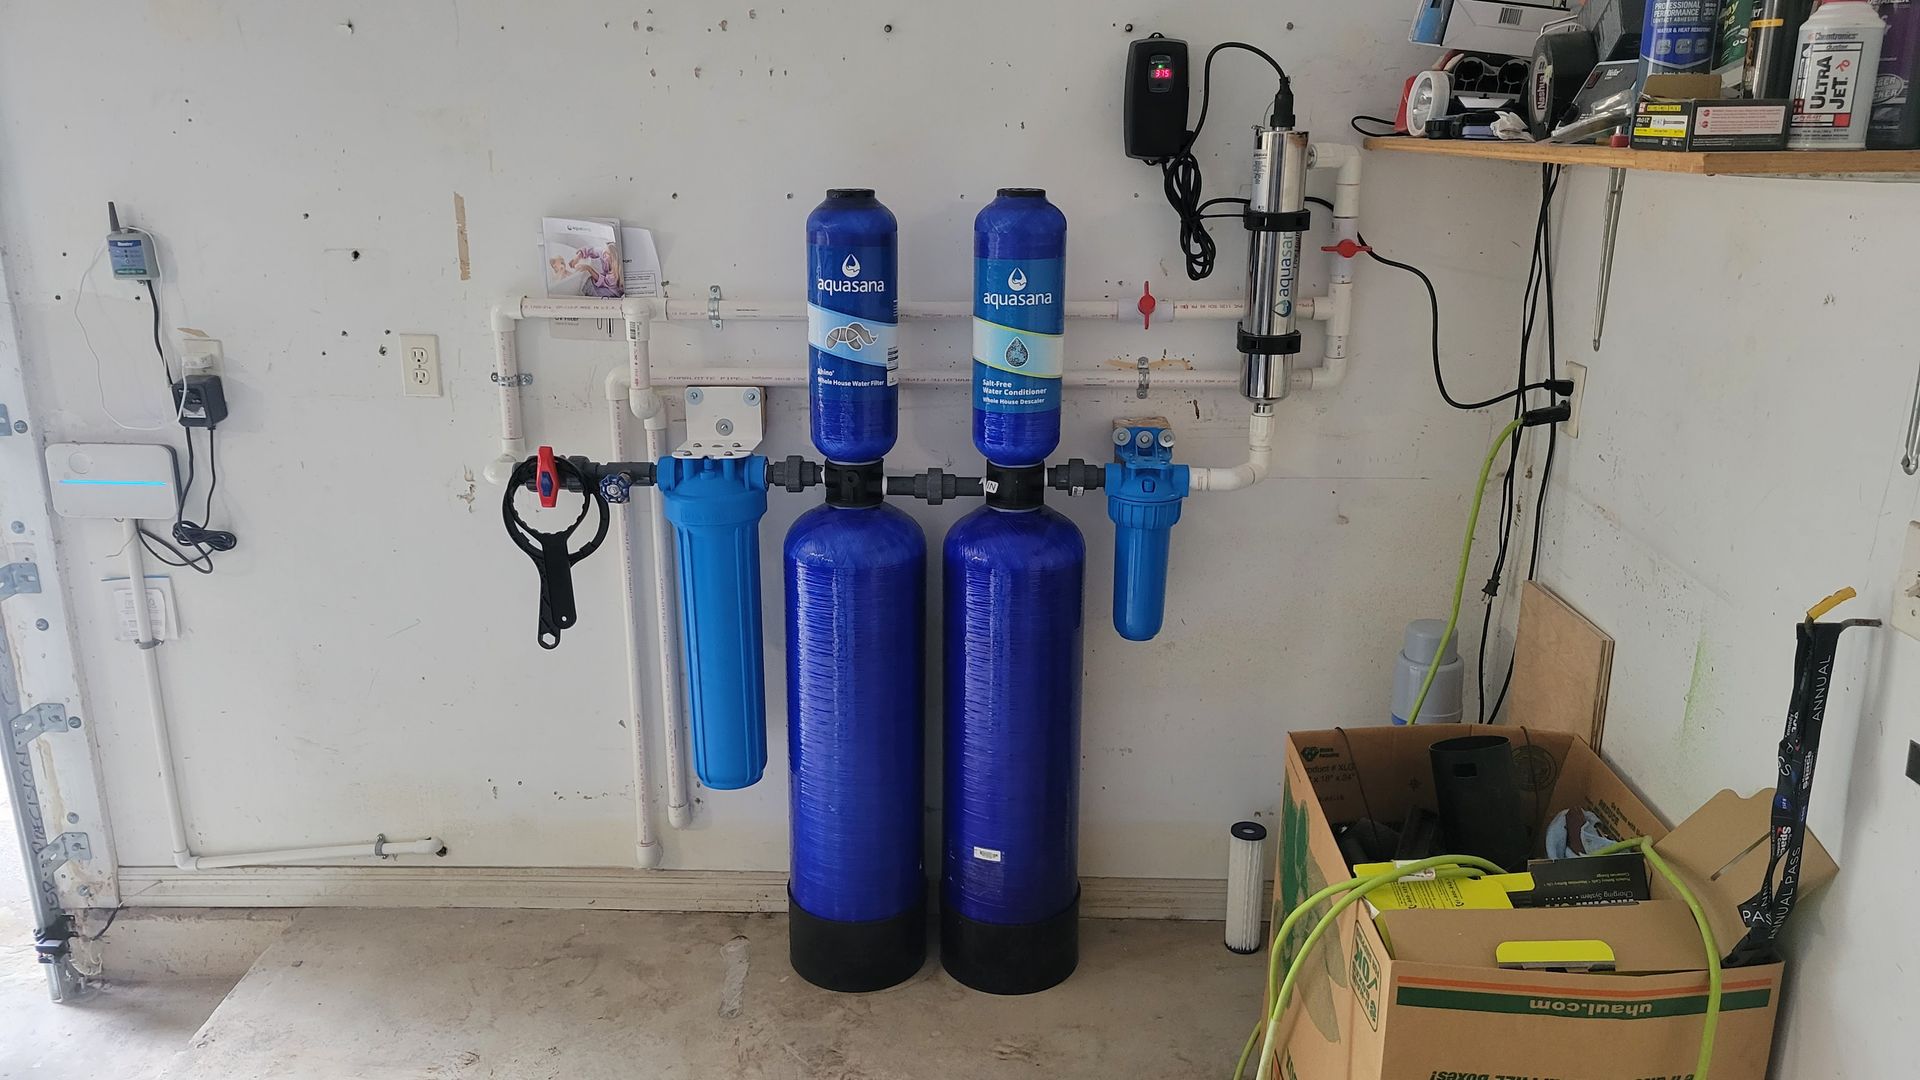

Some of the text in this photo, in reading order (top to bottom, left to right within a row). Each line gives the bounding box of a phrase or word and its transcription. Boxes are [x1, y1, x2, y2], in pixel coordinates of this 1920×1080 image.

[1654, 1, 1700, 10] PROFESSIONAL
[1654, 9, 1699, 18] PERFORMANCE
[1810, 55, 1832, 109] ULTRA
[1537, 74, 1546, 110] Nashua
[817, 278, 885, 296] aquasana
[983, 291, 1052, 310] aquasana
[832, 378, 851, 387] House
[852, 379, 868, 387] Water
[869, 378, 884, 387] Filter
[982, 379, 1012, 388] Salt-Free
[982, 387, 1047, 396] Water Conditioner
[1020, 397, 1044, 405] Descaler
[986, 482, 997, 491] IN
[1811, 654, 1831, 722] ANNUAL
[1784, 848, 1801, 886] PASS
[1529, 999, 1652, 1016] uhaul.com
